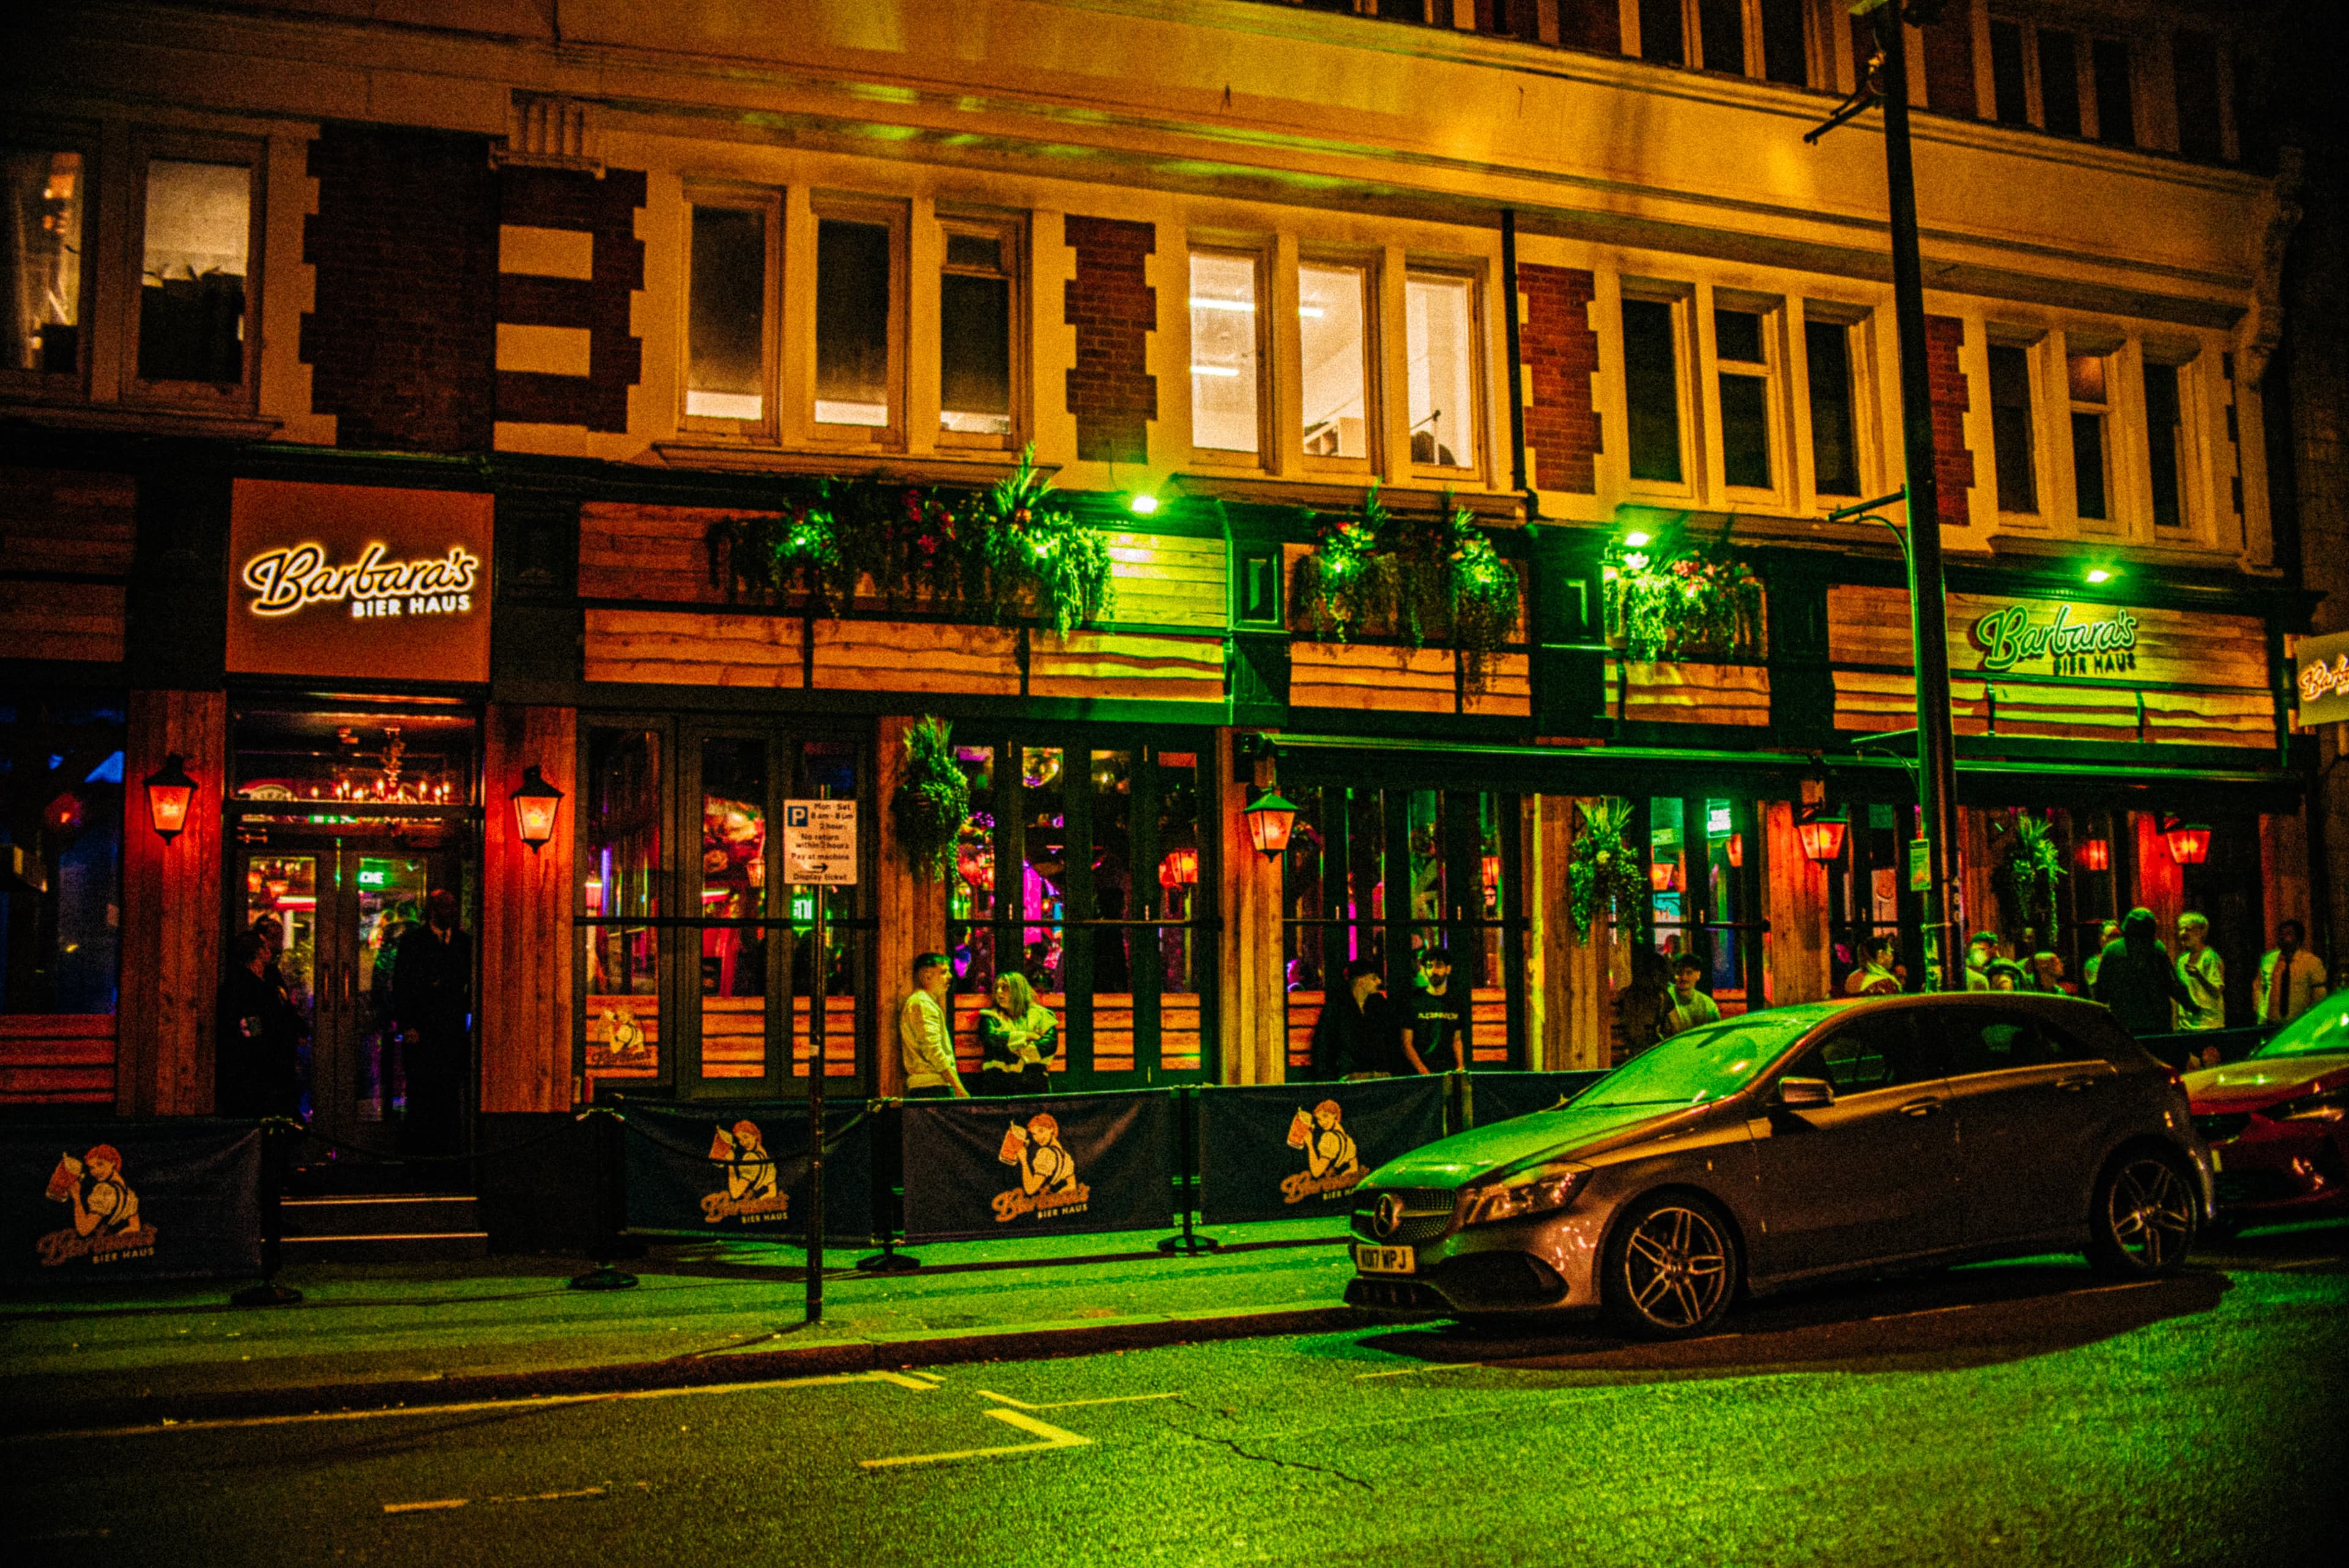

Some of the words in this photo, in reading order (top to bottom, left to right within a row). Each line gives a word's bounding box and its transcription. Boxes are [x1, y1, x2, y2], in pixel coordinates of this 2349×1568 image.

[244, 543, 478, 615] Barbara's
[352, 599, 401, 617] BIER
[409, 595, 470, 614] HAUS
[1976, 604, 2136, 671] Barbara's
[2054, 656, 2087, 676] BIER
[2094, 652, 2137, 674] HAUS
[793, 872, 822, 881] Display
[741, 1214, 761, 1224] BIER
[763, 1211, 789, 1221] HAUS
[1037, 1208, 1058, 1220] BIER
[1061, 1203, 1089, 1215] HAUS
[92, 1252, 118, 1264] BIER
[122, 1246, 155, 1260] HAUS
